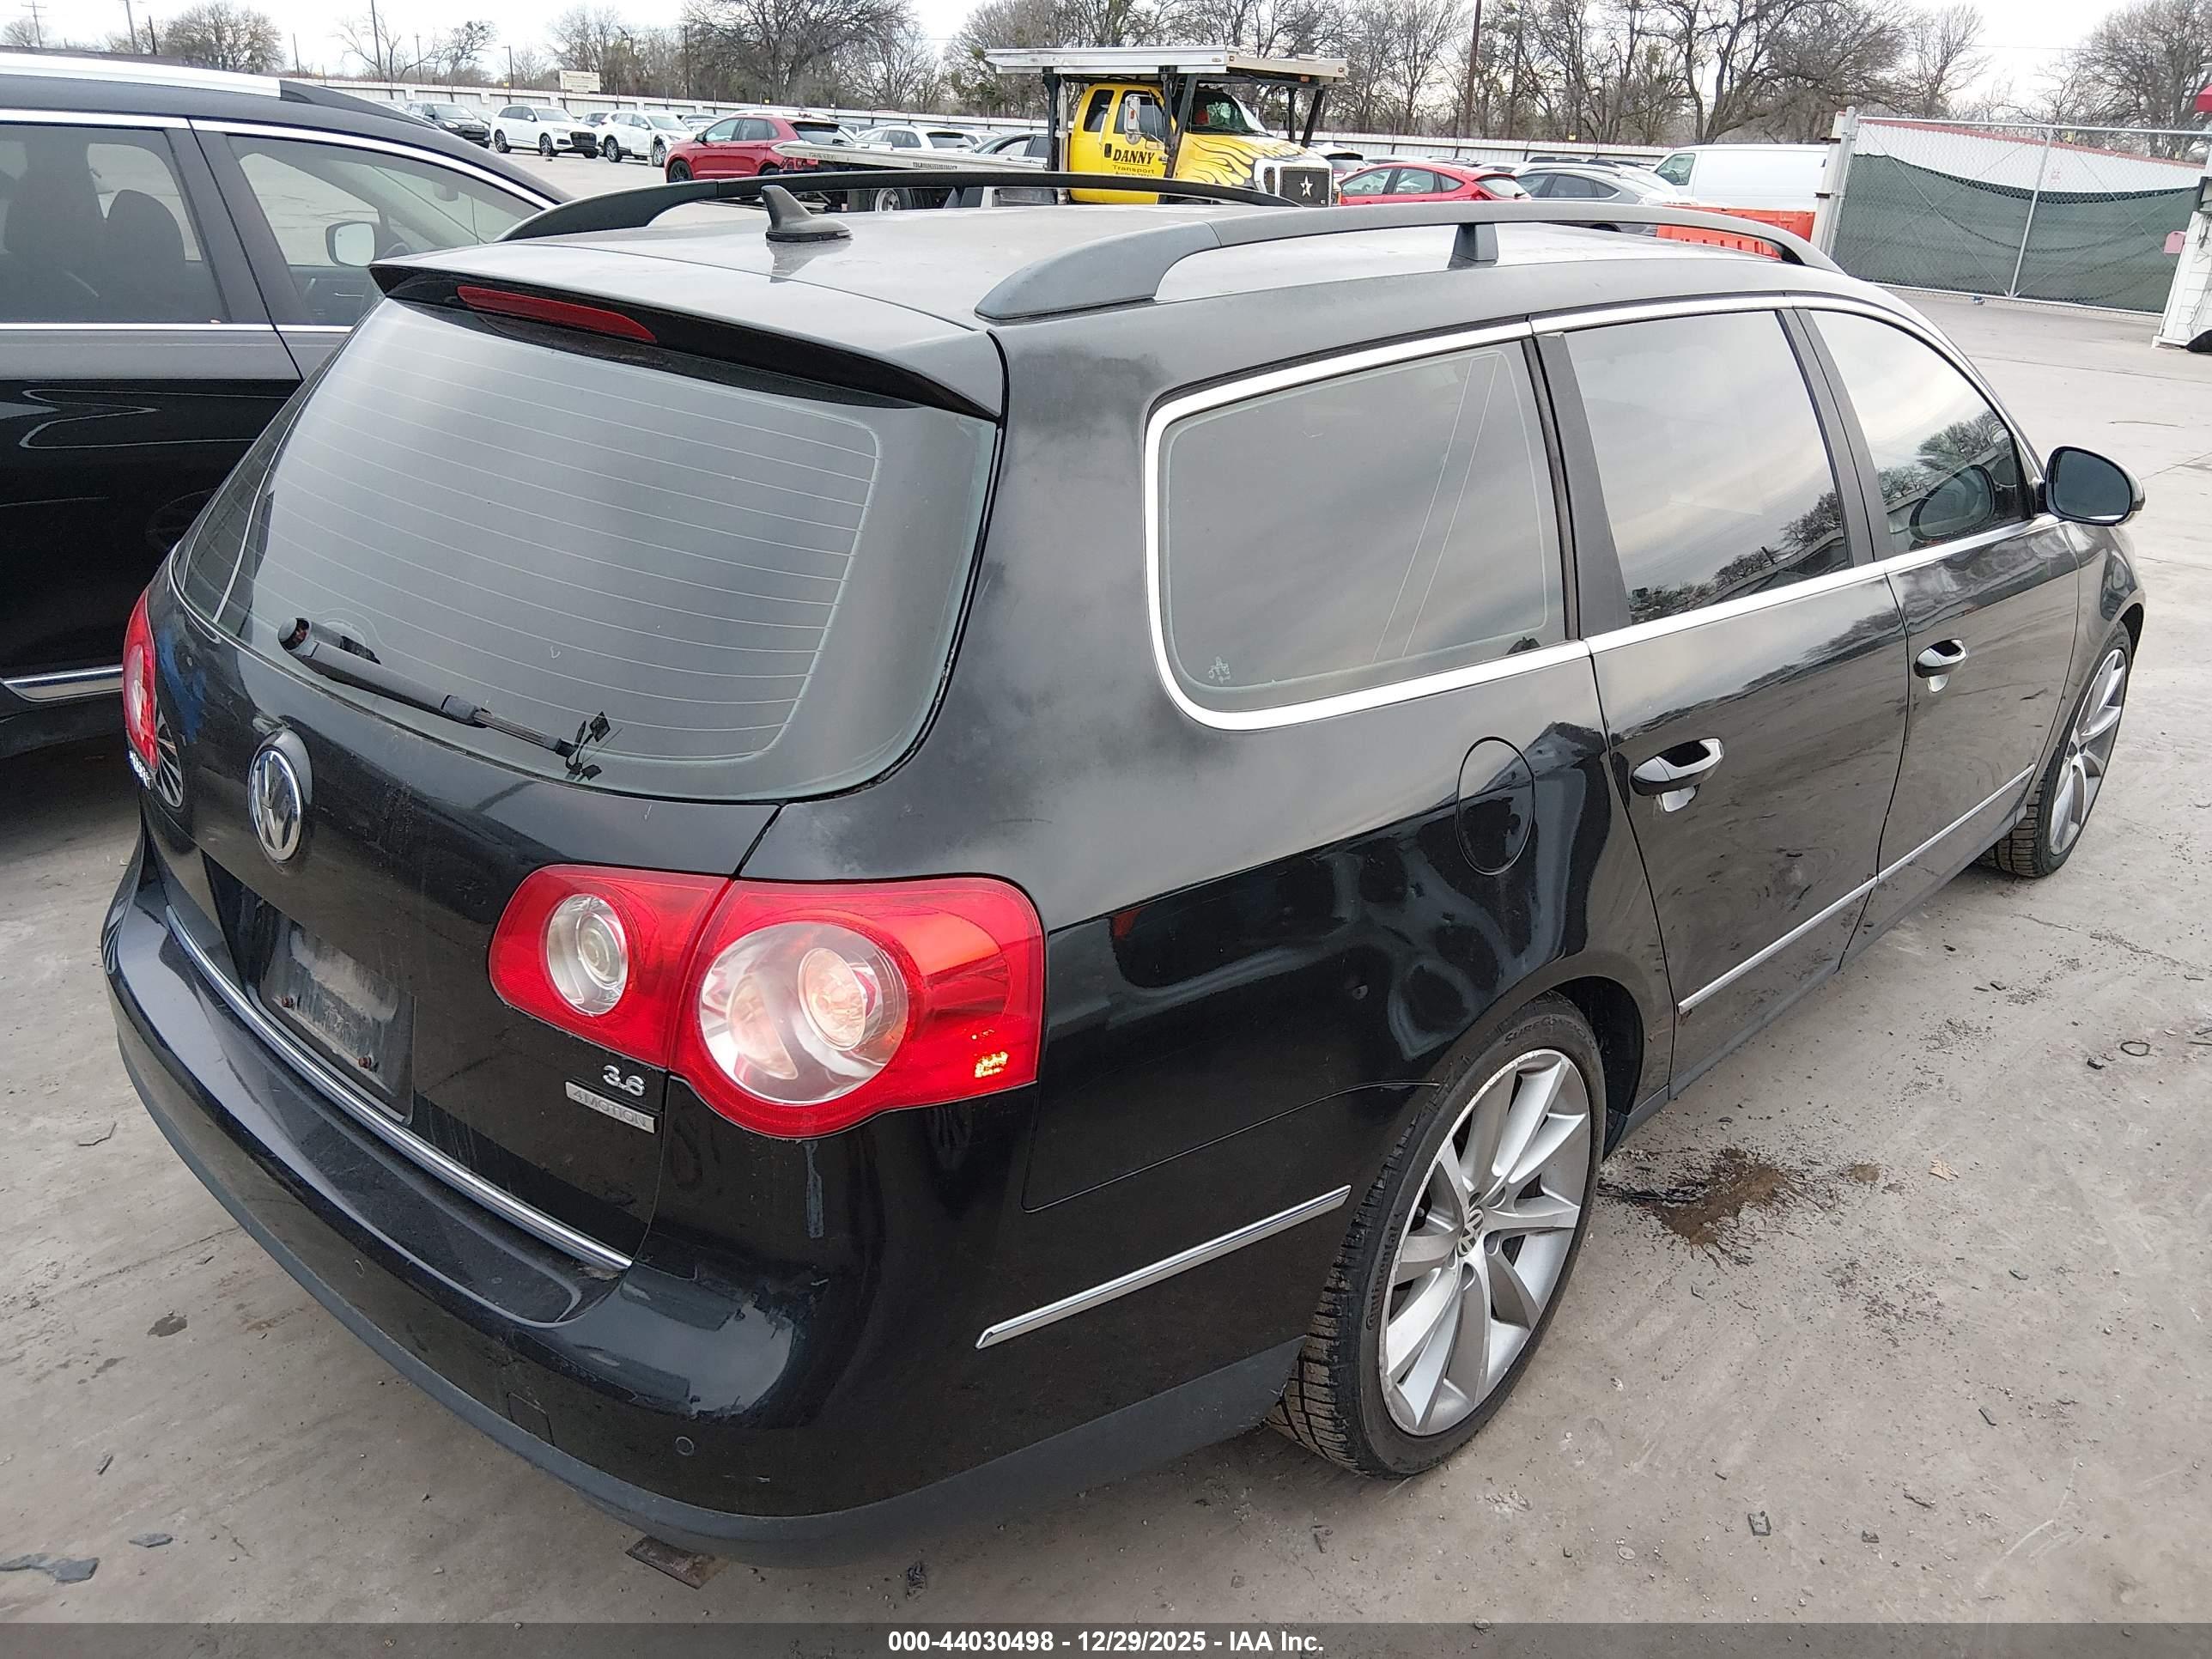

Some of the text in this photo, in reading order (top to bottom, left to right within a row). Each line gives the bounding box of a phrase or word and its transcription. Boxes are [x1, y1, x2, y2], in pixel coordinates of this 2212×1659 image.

[1113, 149, 1154, 165] DANNY
[1113, 164, 1154, 174] Transport
[603, 1065, 646, 1097] 3.6
[573, 1090, 647, 1130] 4MOTION
